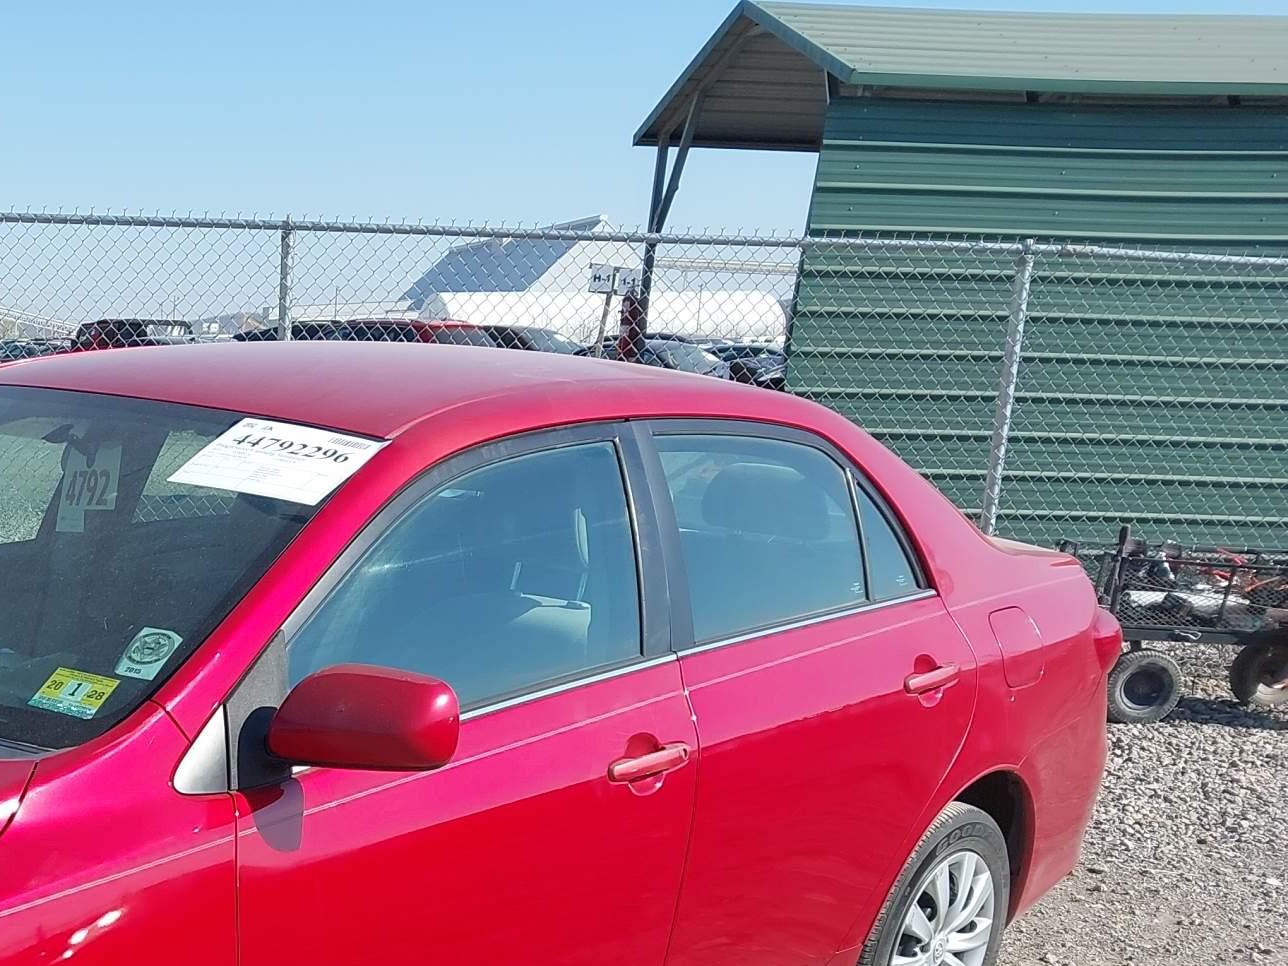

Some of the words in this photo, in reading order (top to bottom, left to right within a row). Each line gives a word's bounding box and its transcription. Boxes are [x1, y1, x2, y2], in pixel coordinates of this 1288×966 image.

[232, 434, 350, 464] 44792296
[66, 469, 111, 506] 4792
[46, 679, 64, 691] 20
[68, 682, 82, 697] 1
[87, 689, 106, 701] 28
